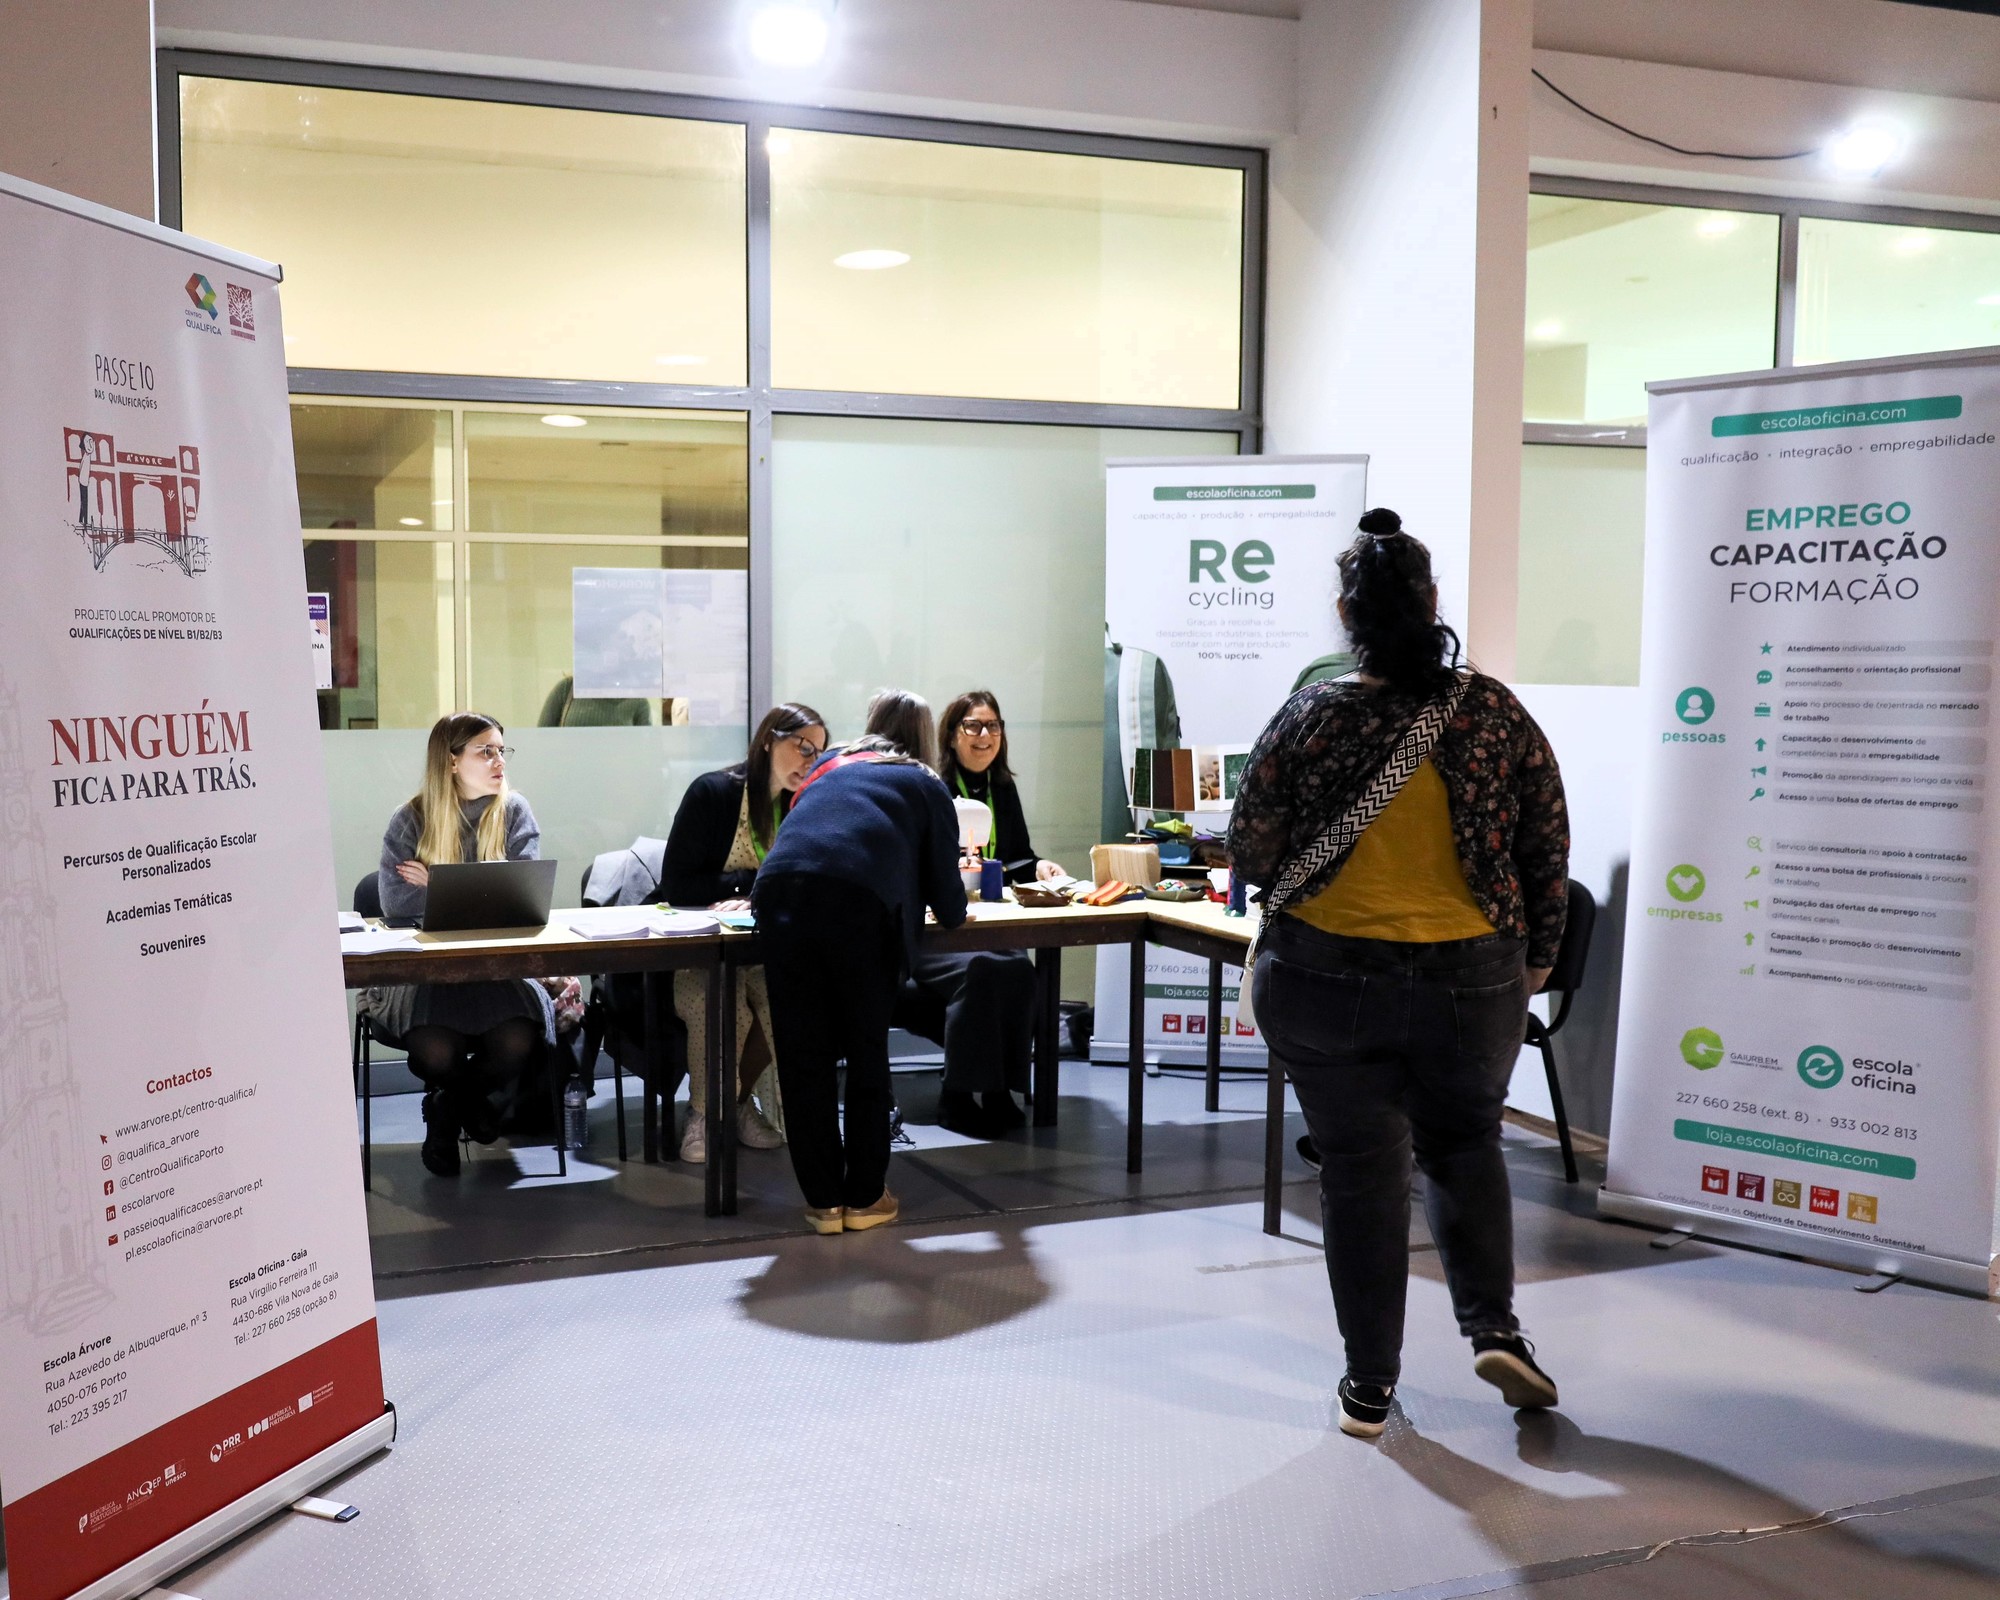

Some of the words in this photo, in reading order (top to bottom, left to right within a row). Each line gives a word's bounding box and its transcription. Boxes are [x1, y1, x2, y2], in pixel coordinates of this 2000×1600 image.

[186, 319, 222, 335] QUALIFICA
[95, 354, 154, 391] PASSEIO
[95, 389, 105, 400] DAS
[109, 393, 157, 409] QUALIFICAÇÕES
[1761, 406, 1907, 432] escolaoficina.com
[1681, 451, 1759, 467] qualificação
[1779, 444, 1853, 459] integração
[1870, 432, 1995, 454] empregabilidade
[1186, 487, 1282, 499] escolaoficina.com
[1132, 512, 1188, 520] capacitação
[1201, 510, 1244, 520] produção
[1258, 509, 1336, 520] empregabilidade
[1746, 501, 1911, 531] EMPREGO
[1189, 539, 1275, 583] Re
[1710, 531, 1947, 567] CAPACITAÇÃO
[1188, 587, 1274, 609] cycling
[1730, 573, 1919, 605] FORMAÇÃO
[74, 608, 116, 621] PROJETO
[119, 610, 149, 622] LOCAL
[152, 611, 203, 623] PROMOTOR
[206, 613, 216, 623] DE
[69, 626, 141, 641] QUALIFICAÇÕES
[144, 629, 156, 639] DE
[159, 628, 185, 639] NÍVEL
[187, 630, 222, 640] B1/B2/B3
[1198, 652, 1222, 660] 100%
[1225, 652, 1263, 662] upcycle.
[1786, 666, 1854, 674] Aconselhamento
[1864, 666, 1908, 675] orientação
[1911, 665, 1961, 674] profissional
[1786, 680, 1842, 689] personalizado
[1784, 700, 1807, 709] Apoio
[48, 699, 252, 765] NINGUÉM
[1662, 730, 1726, 743] pessoas
[1782, 735, 1831, 744] Capacitação
[1841, 736, 1913, 745] desenvolvimento
[1869, 752, 1940, 761] empregabilidade
[52, 776, 117, 807] FICA
[121, 769, 189, 800] PARA
[193, 758, 256, 793] TRÁS.
[1782, 772, 1823, 781] Promoção
[1874, 797, 1904, 806] ofertas
[1920, 800, 1959, 810] emprego
[64, 846, 124, 869] Percursos
[128, 847, 142, 861] de
[146, 836, 218, 857] Qualificação
[220, 831, 258, 847] Escolar
[1821, 845, 1867, 855] consultoria
[1882, 850, 1905, 858] apoio
[1915, 852, 1967, 862] contratação
[122, 857, 212, 881] Personalizados
[1775, 863, 1803, 871] Acesso
[1832, 867, 1854, 875] bolsa
[1870, 870, 1922, 880] profissionais
[106, 901, 171, 924] Academias
[174, 890, 233, 912] Temáticas
[1647, 905, 1723, 922] empresas
[1773, 897, 1818, 909] Divulgação
[1820, 901, 1834, 909] das
[1836, 903, 1866, 912] ofertas
[1868, 905, 1879, 913] de
[1881, 907, 1919, 918] emprego
[140, 934, 206, 956] Souvenires
[1770, 947, 1802, 956] humano
[1771, 932, 1820, 943] Capacitação
[1829, 938, 1872, 949] promoção
[1887, 943, 1961, 958] desenvolvimento
[1182, 966, 1198, 974] 258
[1769, 969, 1842, 983] Acompanhamento
[1852, 1057, 1913, 1076] escola
[146, 1066, 212, 1094] Contactos
[1851, 1074, 1917, 1095] oficina
[115, 1083, 257, 1138] www.arvore.pt/centro-qualifica/
[1676, 1092, 1700, 1105] 227
[1703, 1096, 1729, 1109] 660
[1733, 1101, 1757, 1115] 258
[1761, 1105, 1791, 1121] (ext.
[1794, 1111, 1809, 1124] 8)
[1830, 1116, 1856, 1131] 933
[1860, 1121, 1890, 1136] 002
[1894, 1127, 1918, 1141] 813
[117, 1128, 200, 1165] @qualifica_arvore
[1706, 1127, 1879, 1169] loja.escolaoficina.com
[120, 1145, 224, 1189] @CentroQualificaPorto
[121, 1186, 175, 1214] escolarvore
[123, 1178, 263, 1240] passeioqualificacoes@arvore.pt
[125, 1206, 243, 1262] pl.escolaoficina@arvore.pt
[1743, 1209, 1782, 1224] Objetivos
[1784, 1217, 1795, 1225] de
[1797, 1219, 1871, 1241] Desenvolvimento
[1873, 1235, 1926, 1251] Sustentável
[229, 1272, 256, 1289] Escola
[257, 1259, 286, 1279] Oficina
[290, 1248, 308, 1266] Gaia
[230, 1293, 247, 1308] Rua
[249, 1280, 278, 1300] Virgílio
[279, 1269, 308, 1289] Ferreira
[309, 1261, 318, 1273] 111
[232, 1300, 274, 1327] 4430-686
[274, 1292, 290, 1308] Vila
[291, 1284, 311, 1301] Nova
[312, 1278, 321, 1291] de
[323, 1270, 339, 1287] Gaia
[234, 1329, 251, 1346] Tel.:
[252, 1323, 266, 1339] 227
[268, 1315, 285, 1331] 660
[286, 1306, 301, 1323] 258
[302, 1296, 328, 1316] (opção
[328, 1289, 338, 1302] 8)
[43, 1351, 76, 1372] Escola
[78, 1334, 112, 1357] Árvore
[45, 1377, 65, 1394] Rua
[68, 1356, 112, 1380] Azevedo
[113, 1350, 126, 1364] de
[128, 1321, 189, 1356] Albuquerque,
[190, 1314, 200, 1328] nº
[202, 1311, 209, 1322] 3
[47, 1383, 98, 1414] 4050-076
[100, 1370, 127, 1391] Porto
[49, 1417, 69, 1436] Tel.:
[70, 1405, 91, 1425] 223
[92, 1396, 112, 1415] 395
[113, 1388, 128, 1405] 217
[223, 1433, 241, 1451] PRR
[126, 1476, 161, 1503] ANQEP
[165, 1471, 186, 1486] unesco
